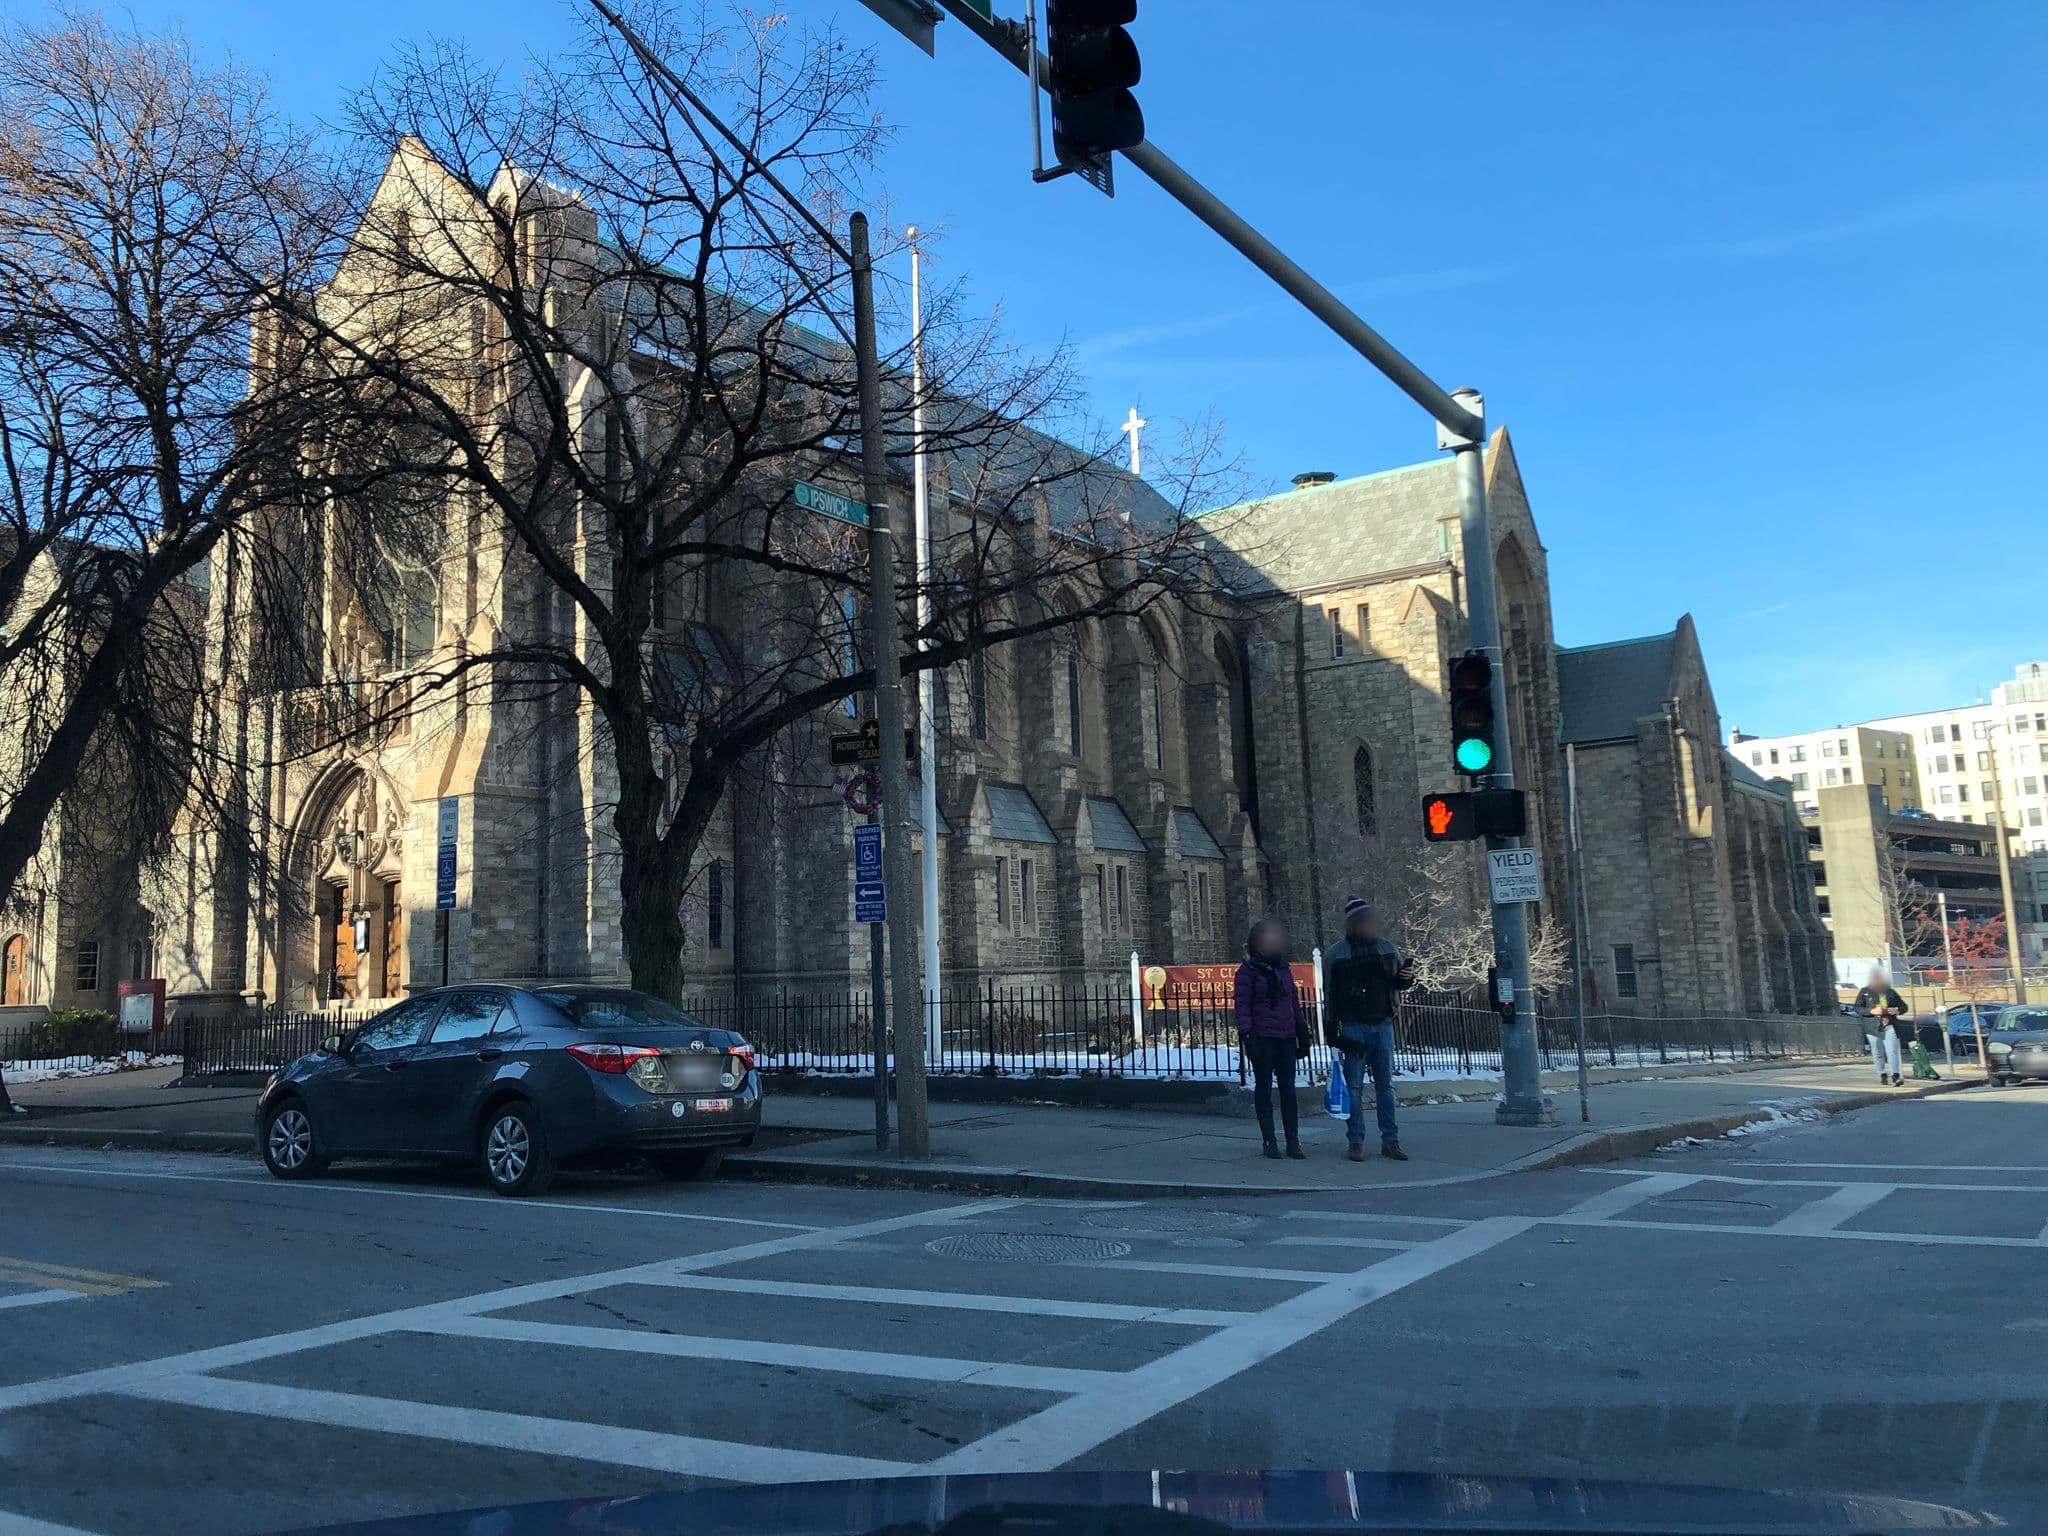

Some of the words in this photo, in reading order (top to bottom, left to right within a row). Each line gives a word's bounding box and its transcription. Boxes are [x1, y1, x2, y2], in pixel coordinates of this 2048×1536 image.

[810, 488, 849, 518] IPSWICH
[836, 741, 866, 751] ROBERT
[1493, 853, 1533, 867] YIELD
[1511, 886, 1537, 898] TURNS
